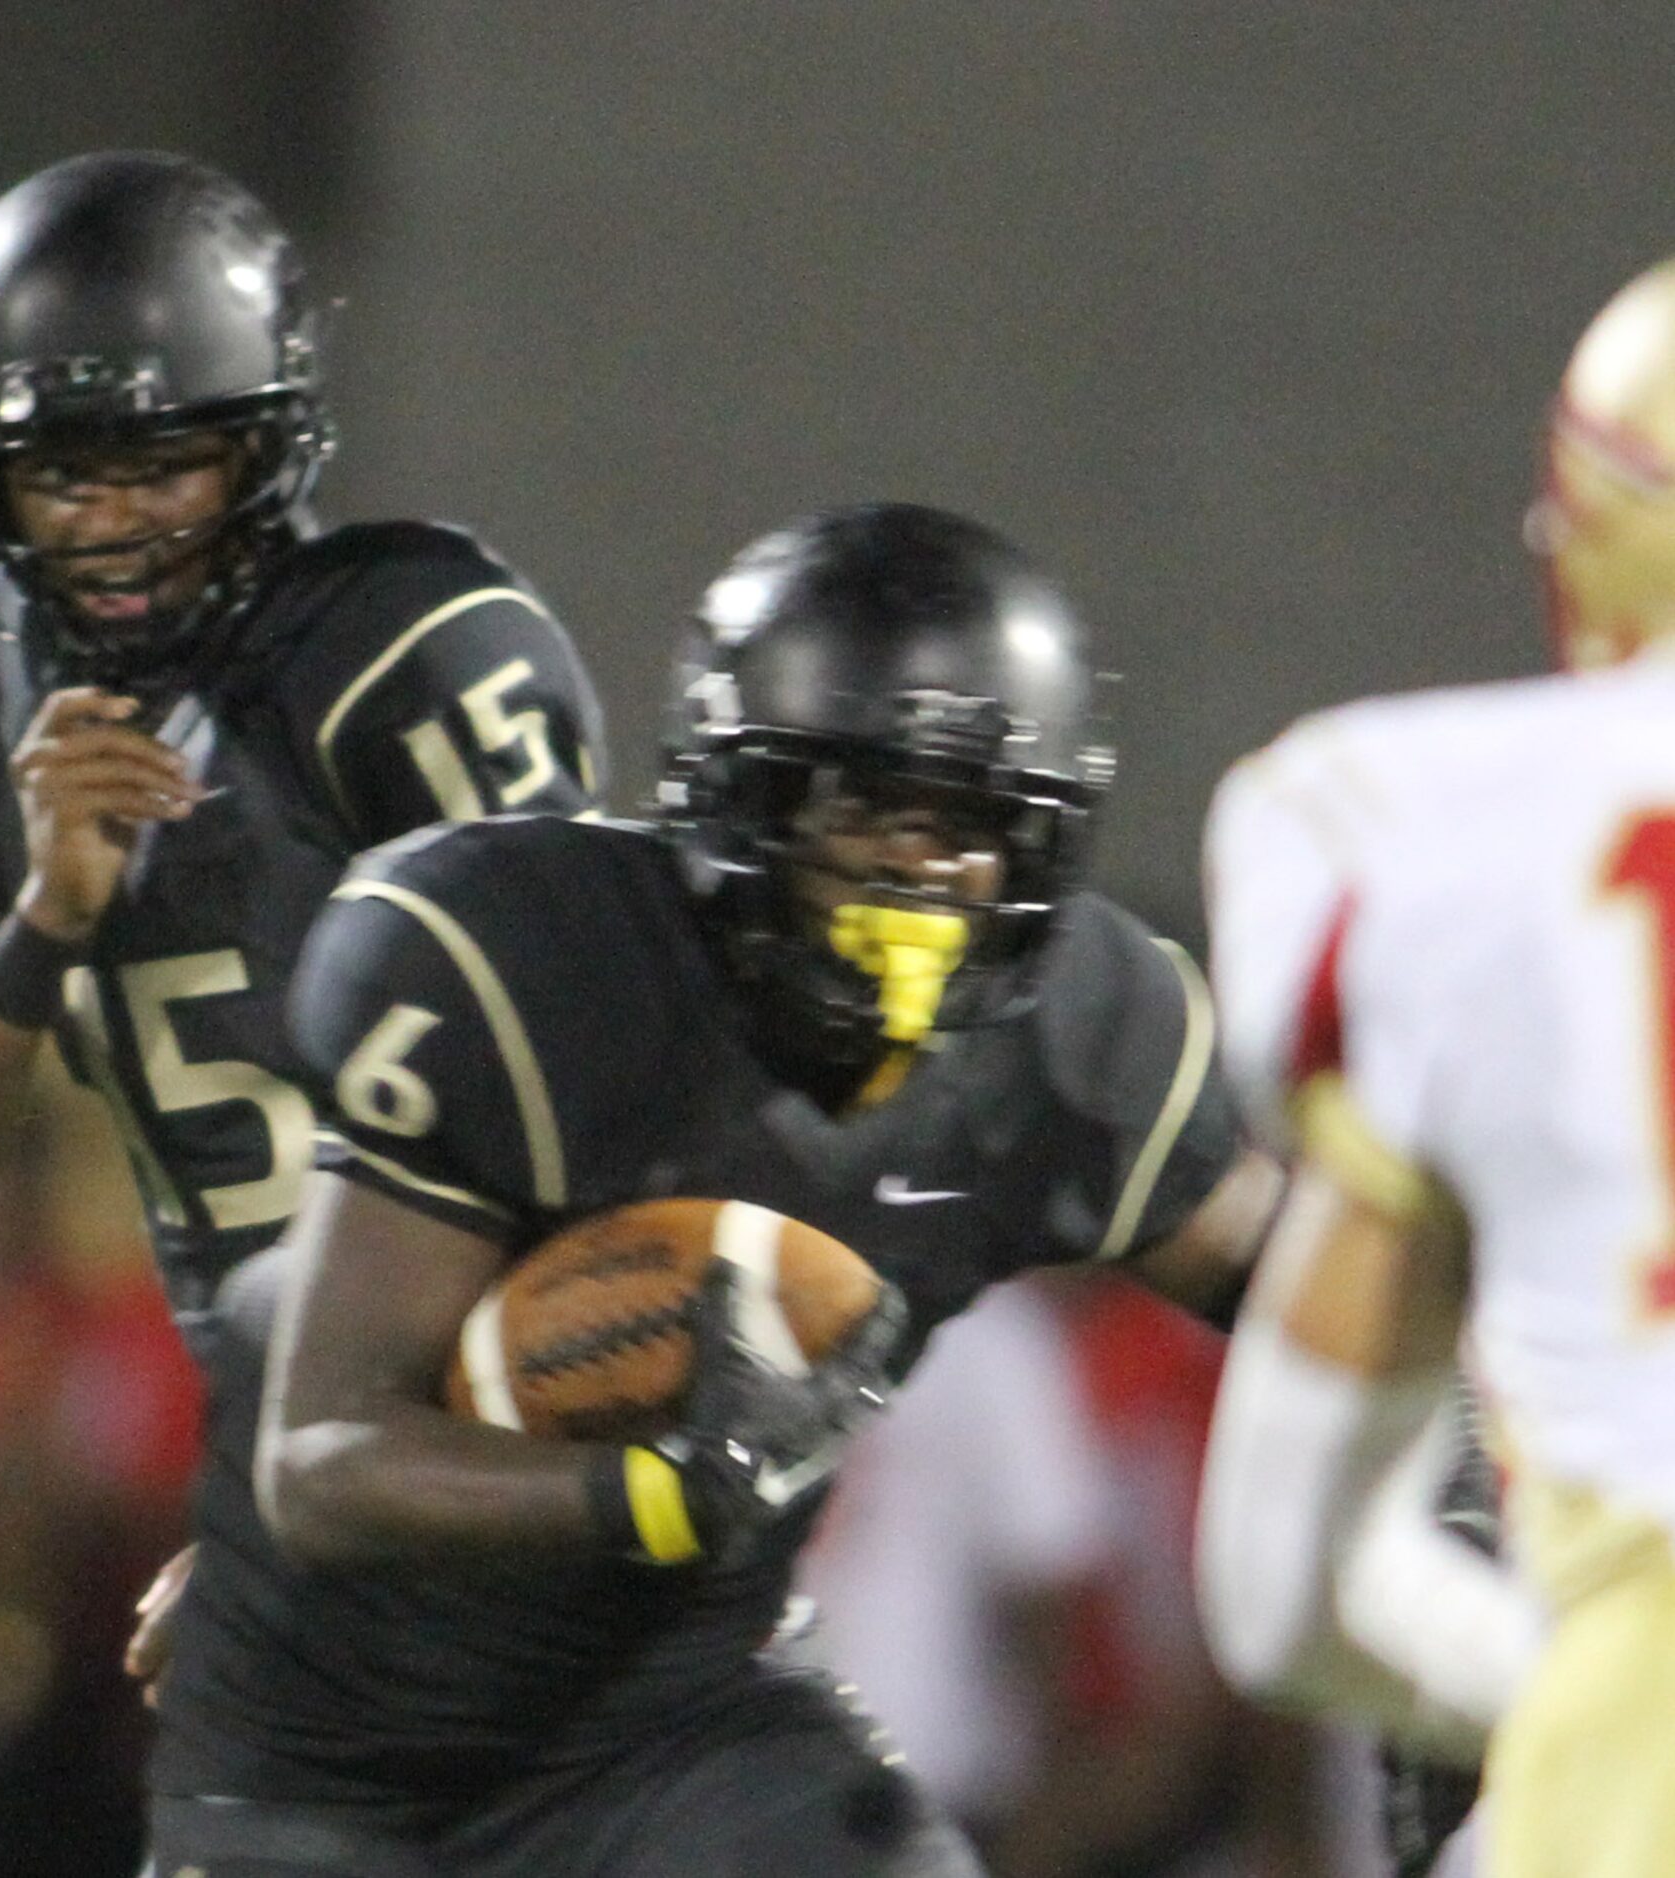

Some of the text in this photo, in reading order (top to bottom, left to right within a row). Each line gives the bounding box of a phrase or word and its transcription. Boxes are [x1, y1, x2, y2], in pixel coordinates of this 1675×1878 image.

[402, 660, 558, 821] 15
[62, 947, 320, 1231] 15
[336, 1004, 442, 1137] 6
